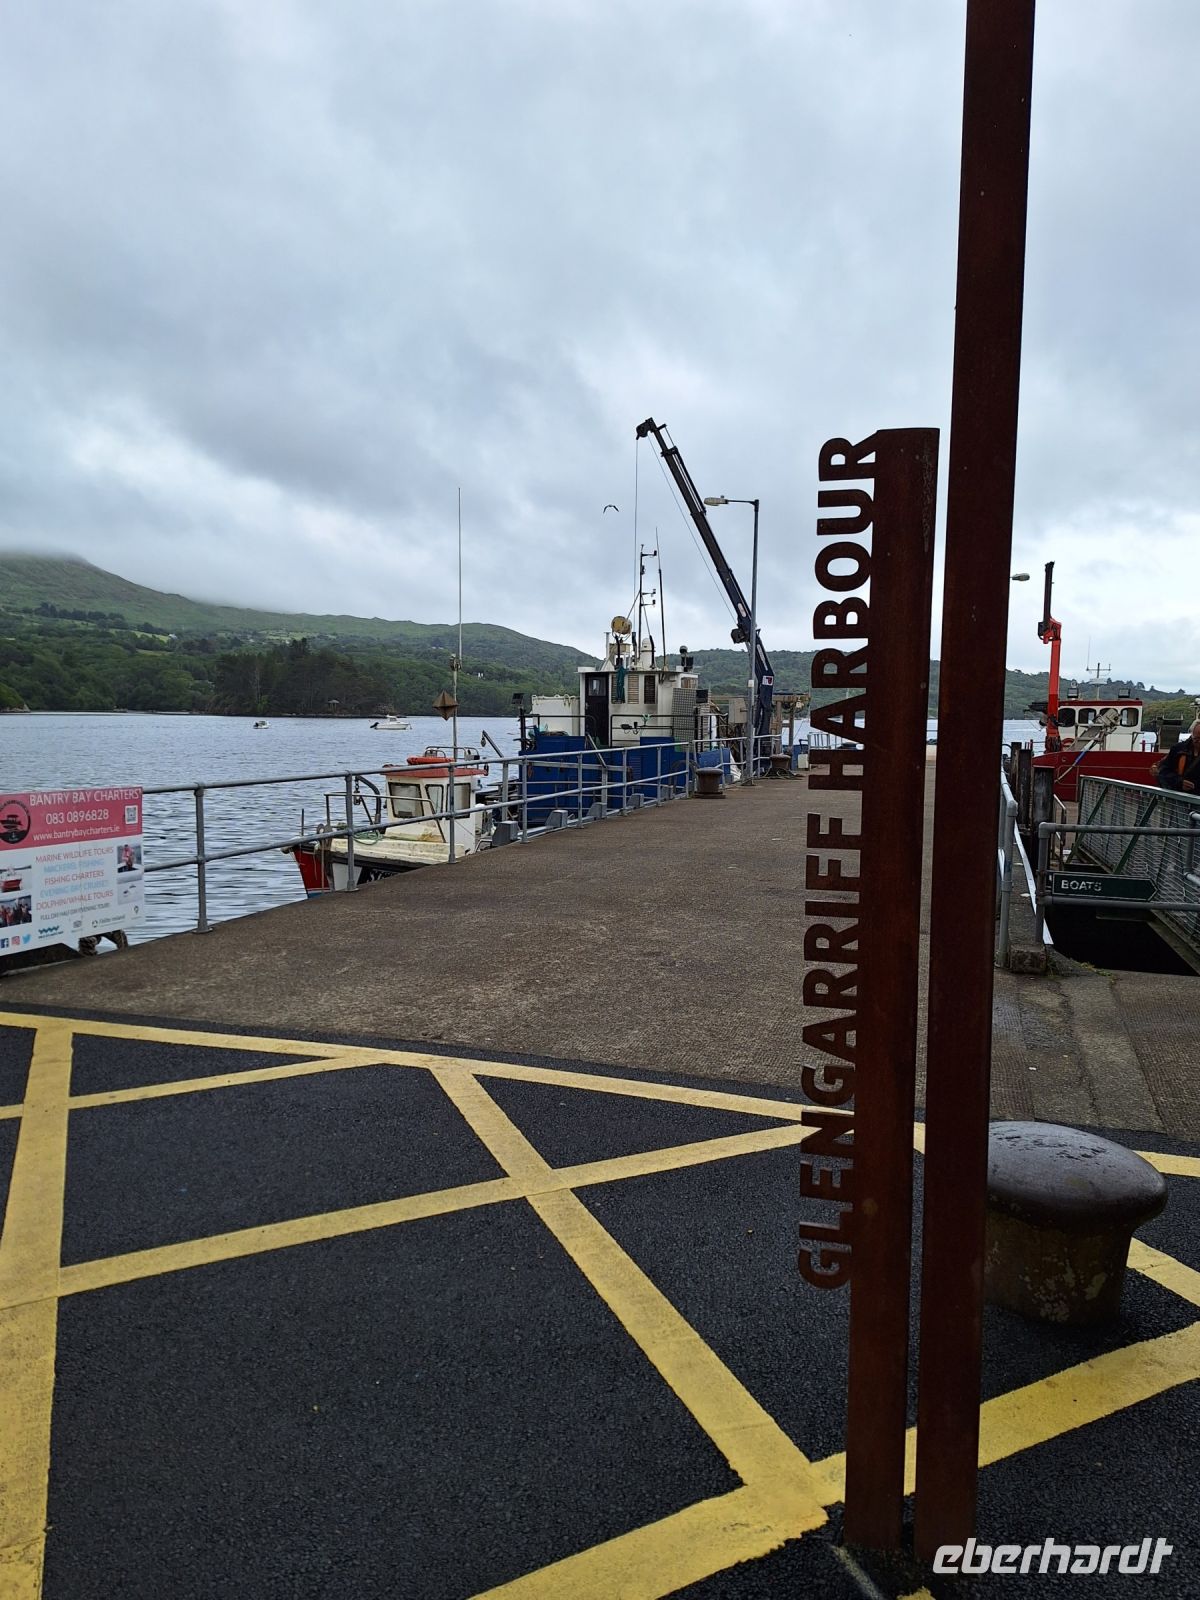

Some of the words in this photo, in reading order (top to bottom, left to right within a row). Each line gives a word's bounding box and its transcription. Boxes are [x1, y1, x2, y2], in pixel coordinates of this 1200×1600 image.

[807, 430, 877, 790] HARBOUR
[29, 793, 70, 806] BANTRY
[72, 791, 92, 802] BAY
[46, 813, 64, 825] 083
[66, 809, 109, 823] 0896828
[33, 825, 120, 841] www.bantrybaycharters.ie
[36, 853, 63, 863] MARINE
[63, 849, 93, 859] WILDLIFE
[93, 847, 114, 857] TOURS
[45, 875, 71, 886] FISHING
[71, 869, 104, 881] CHARTERS
[1061, 879, 1102, 892] BOATS
[93, 889, 114, 900] TOURS
[798, 813, 862, 1290] GLENGARRIFF
